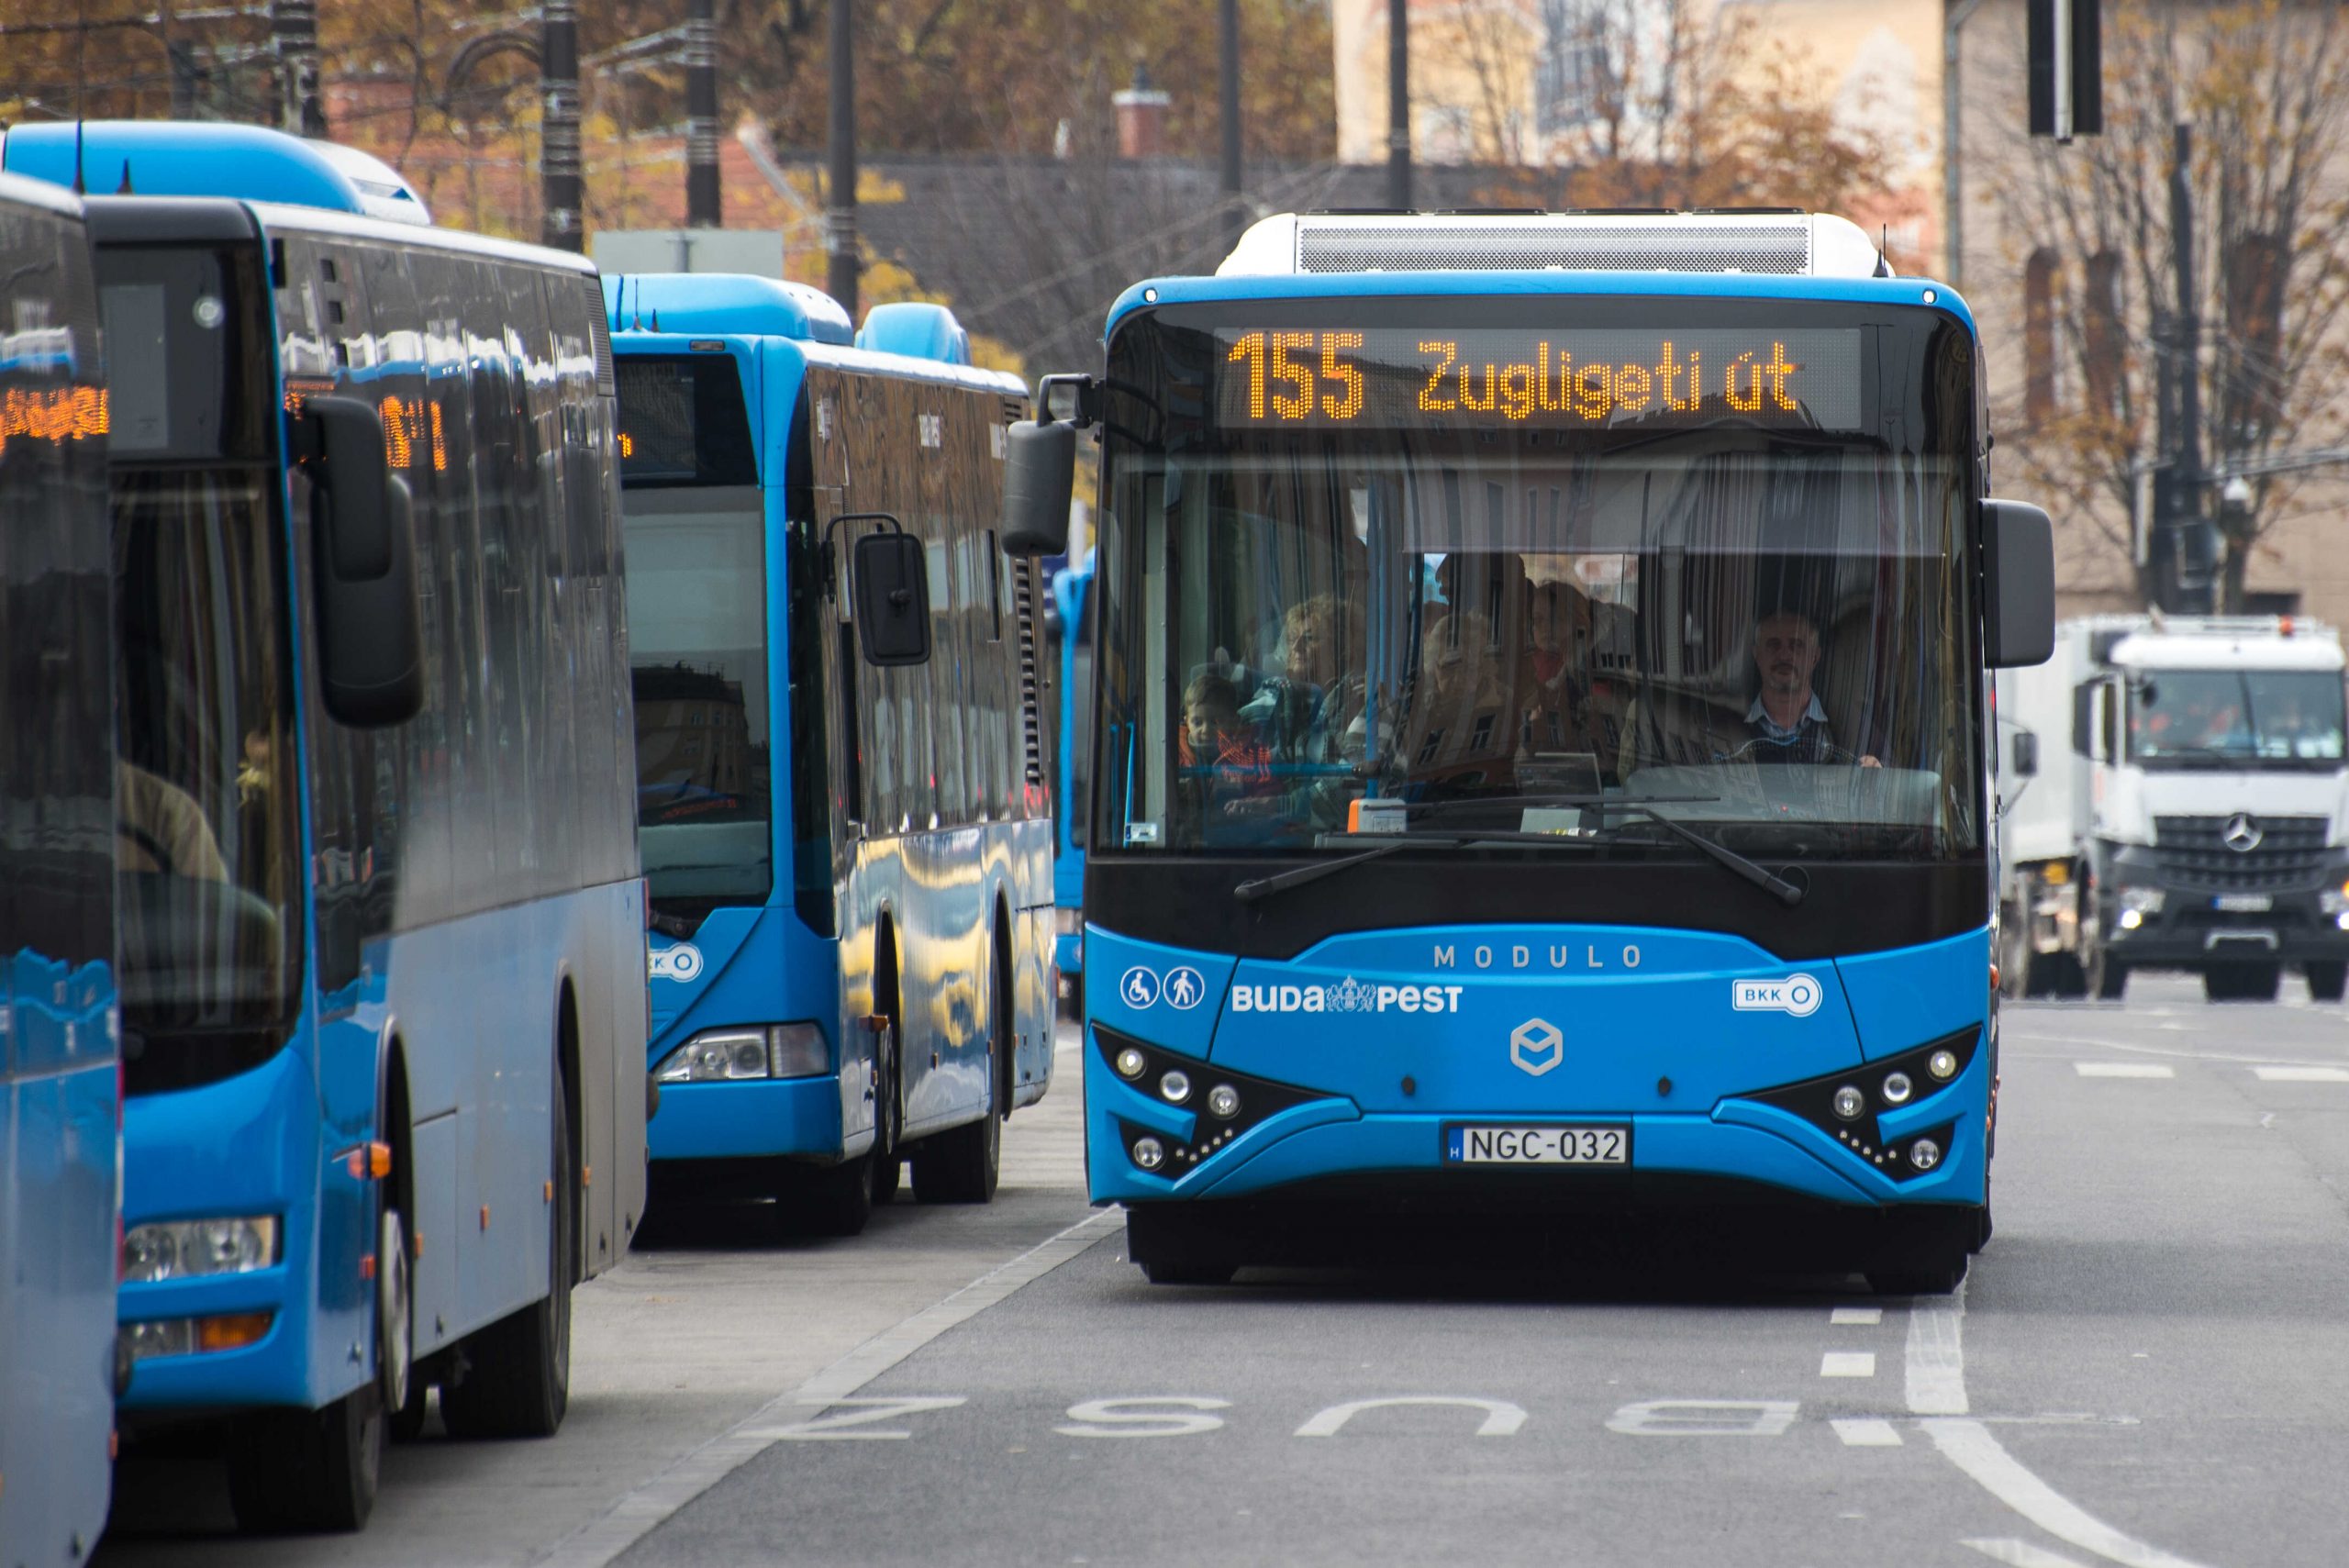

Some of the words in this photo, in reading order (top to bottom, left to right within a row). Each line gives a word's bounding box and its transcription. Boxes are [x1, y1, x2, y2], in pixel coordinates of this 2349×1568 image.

[1229, 332, 1364, 420] 155
[1419, 341, 1701, 420] Zugligeti
[1726, 341, 1797, 411] út
[1433, 945, 1642, 969] MODULO
[1744, 989, 1782, 1001] BKK
[1471, 1130, 1620, 1161] NGC-032
